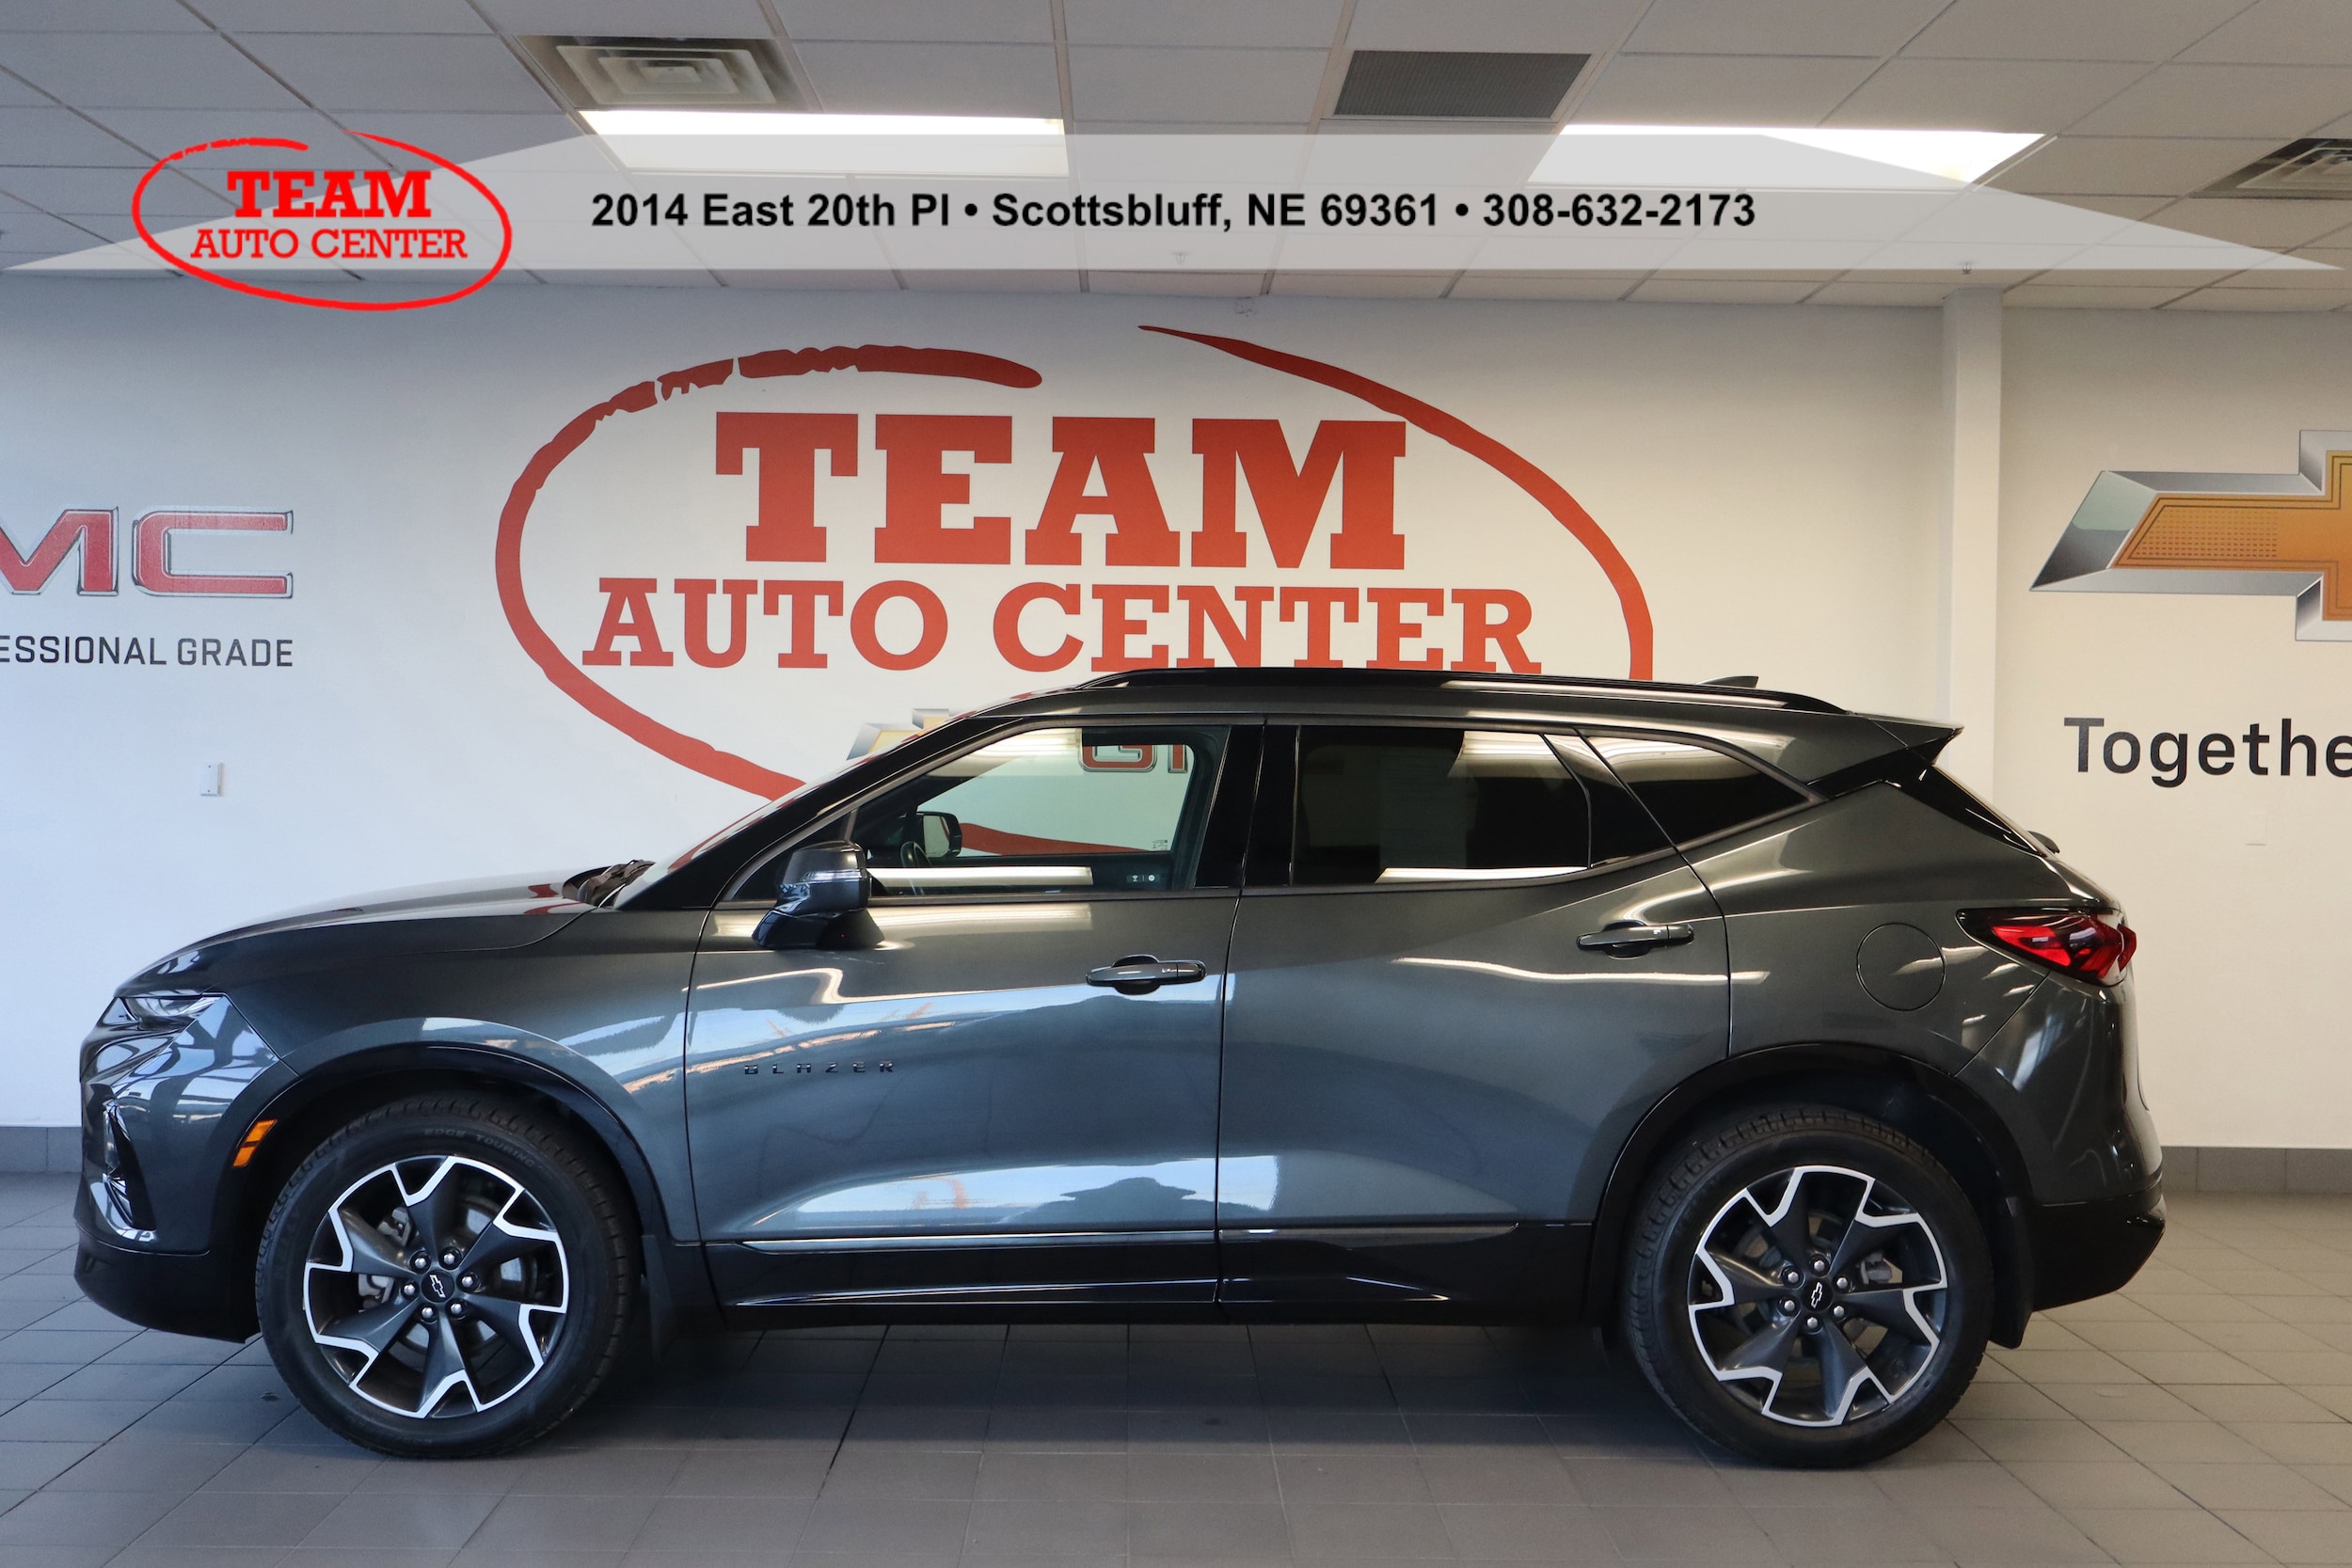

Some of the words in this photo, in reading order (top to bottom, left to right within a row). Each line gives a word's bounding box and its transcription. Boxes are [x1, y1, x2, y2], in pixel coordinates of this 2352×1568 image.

[716, 411, 1406, 571] TEAM
[177, 638, 294, 668] GRADE
[582, 577, 948, 671] AUTO
[993, 581, 1542, 673] CENTER
[2063, 717, 2352, 788] Togethe
[744, 1060, 894, 1075] BLAZER
